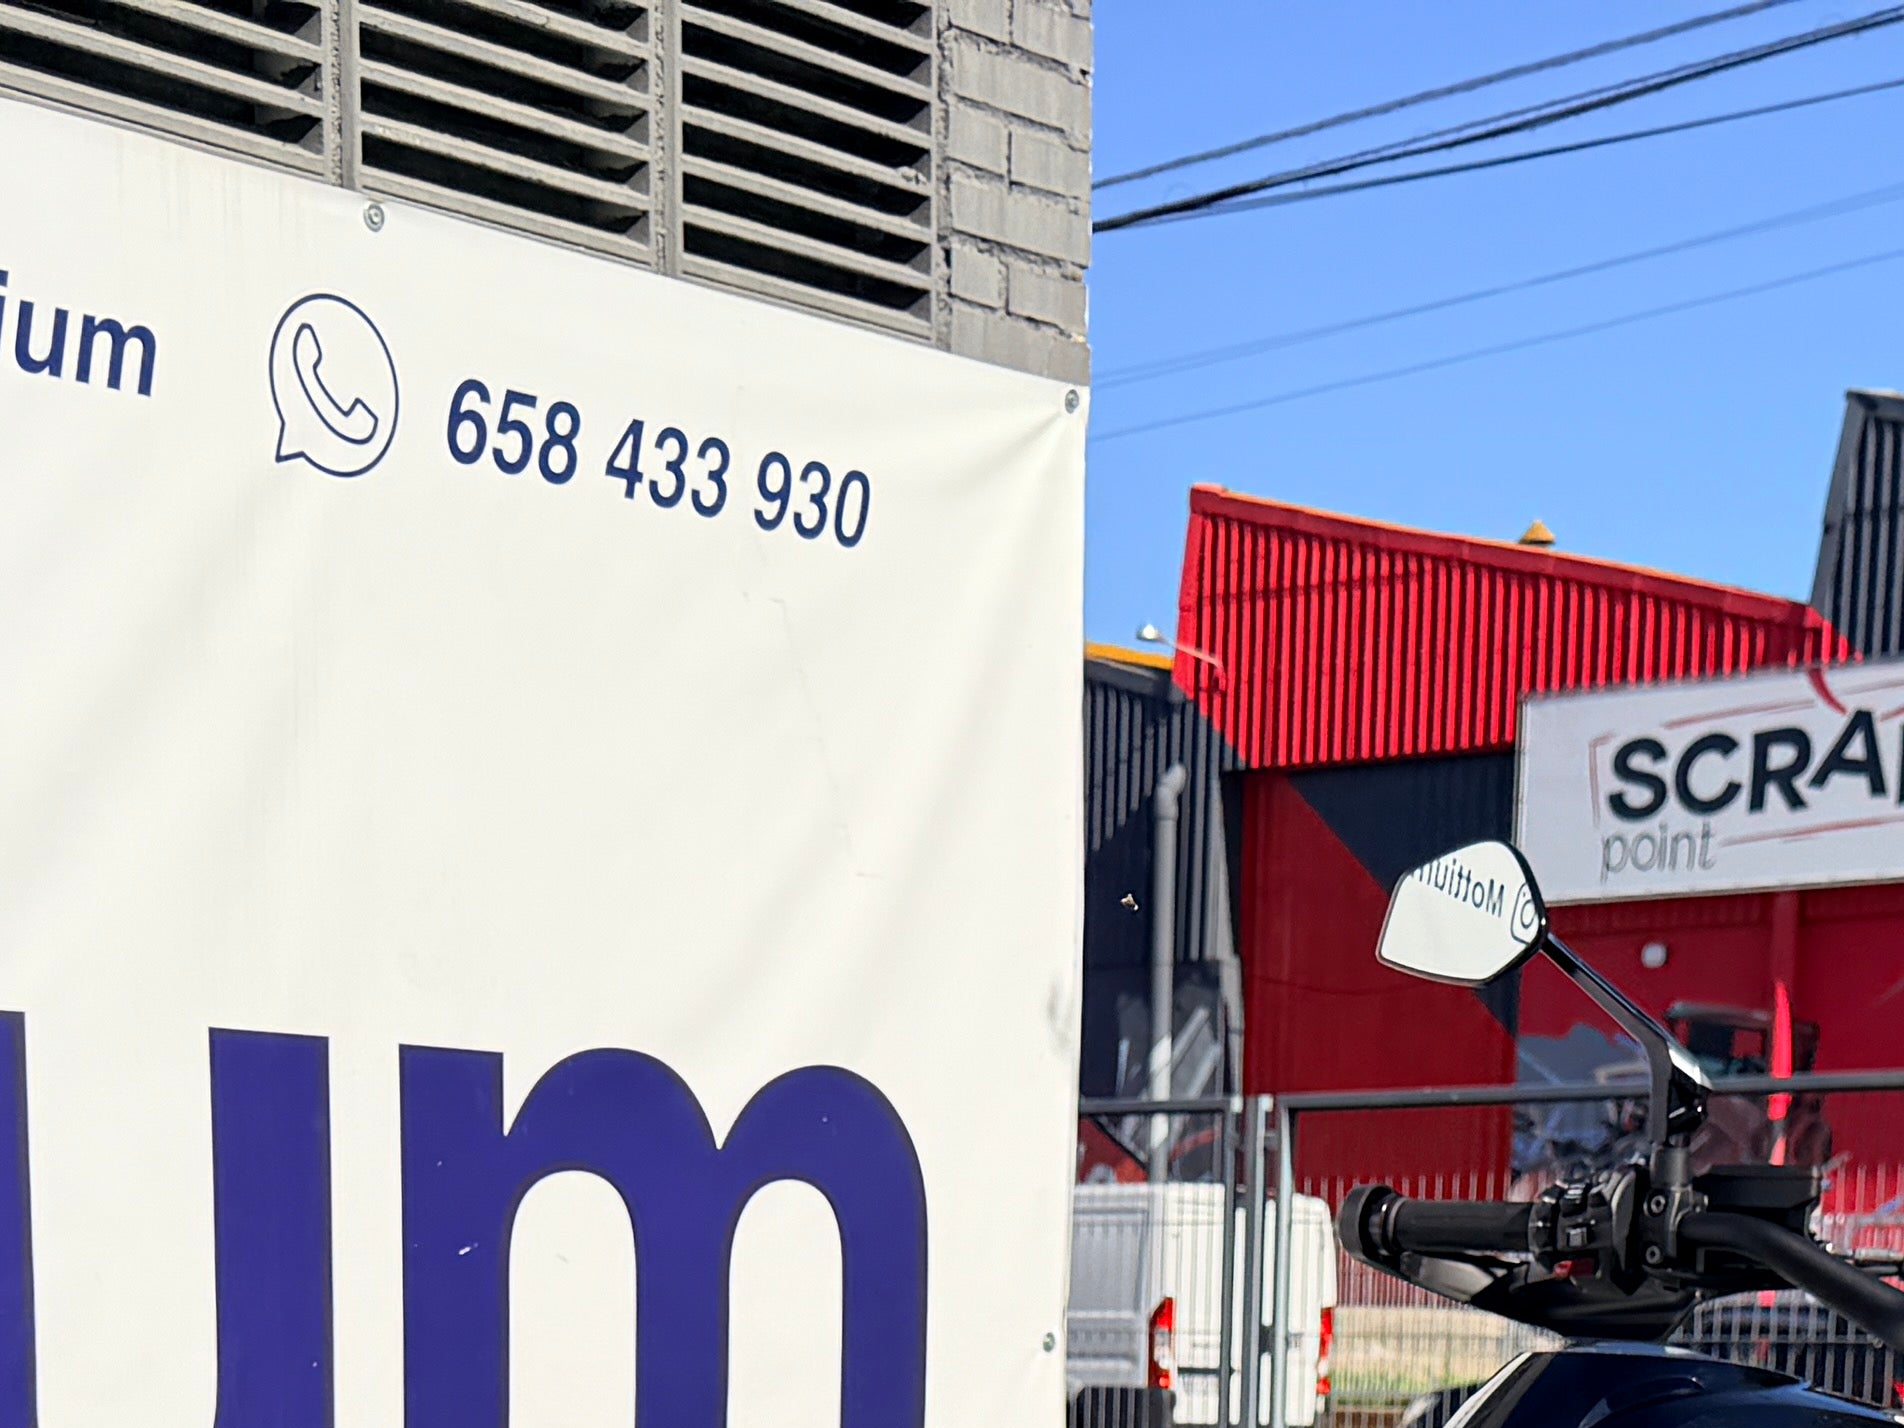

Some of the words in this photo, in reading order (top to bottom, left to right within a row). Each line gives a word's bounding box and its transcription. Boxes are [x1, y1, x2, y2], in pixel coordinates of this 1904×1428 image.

[447, 379, 581, 485] 658
[606, 420, 730, 518] 433
[755, 452, 871, 548] 930
[1601, 822, 1717, 886] point
